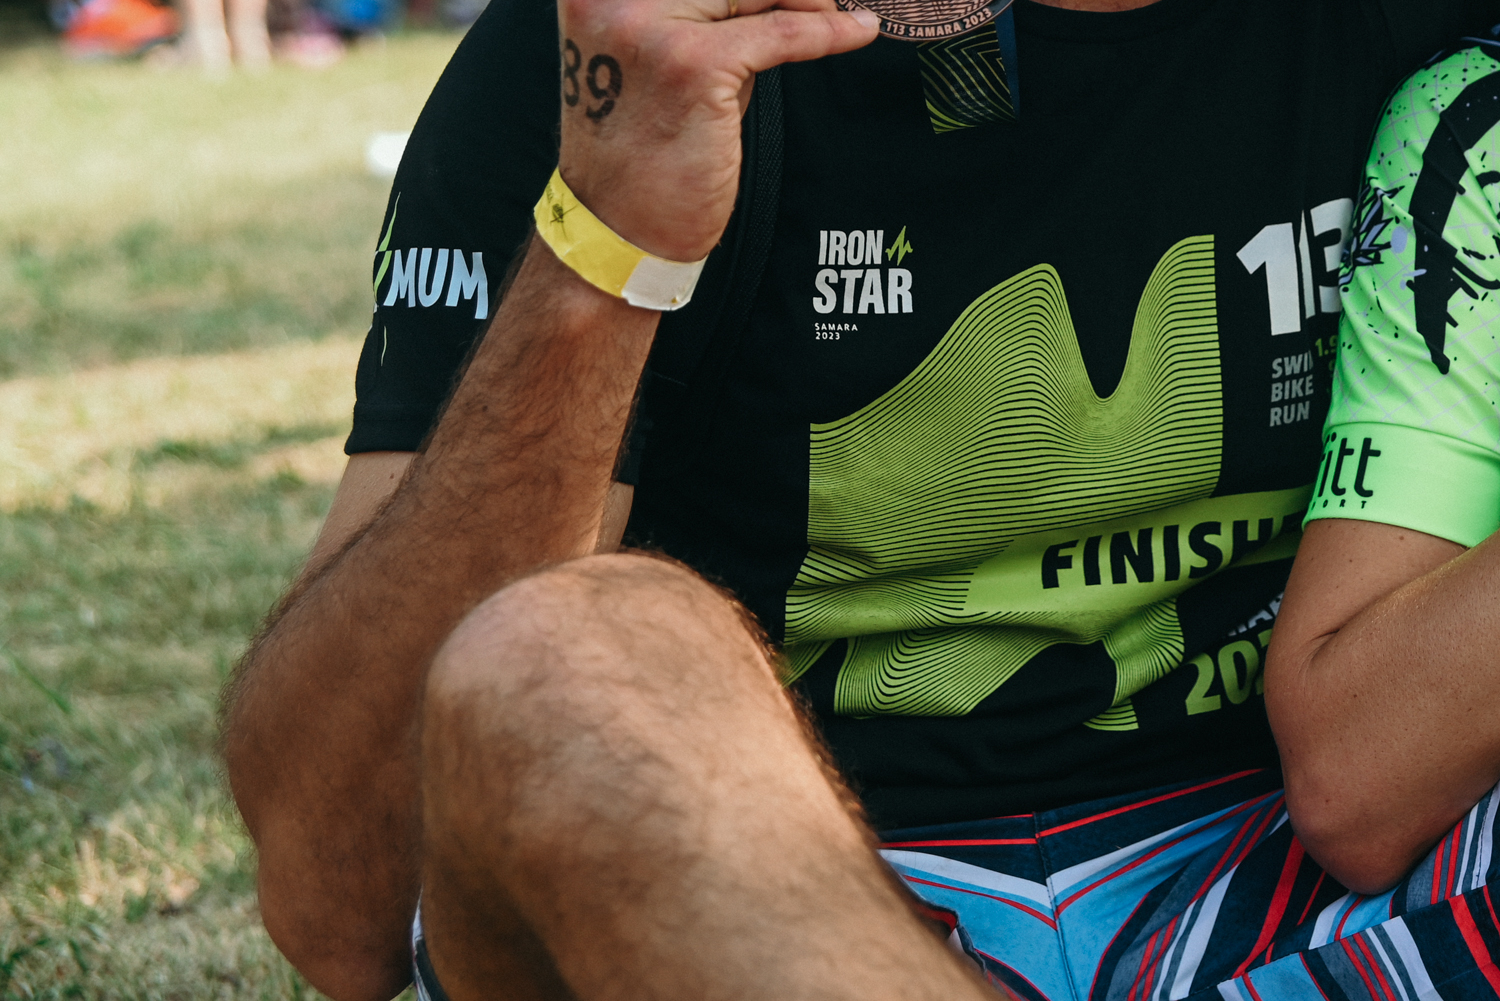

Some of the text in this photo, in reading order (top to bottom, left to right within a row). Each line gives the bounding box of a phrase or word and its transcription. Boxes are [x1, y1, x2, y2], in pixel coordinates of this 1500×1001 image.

[886, 22, 906, 35] 113
[908, 21, 962, 37] SAMARA
[963, 7, 993, 29] 2023
[818, 229, 884, 266] IRON
[812, 268, 913, 315] STAR
[814, 322, 858, 331] SAMARA
[815, 331, 841, 340] 2023
[1270, 374, 1314, 403] BIKE
[1269, 400, 1311, 427] RUN
